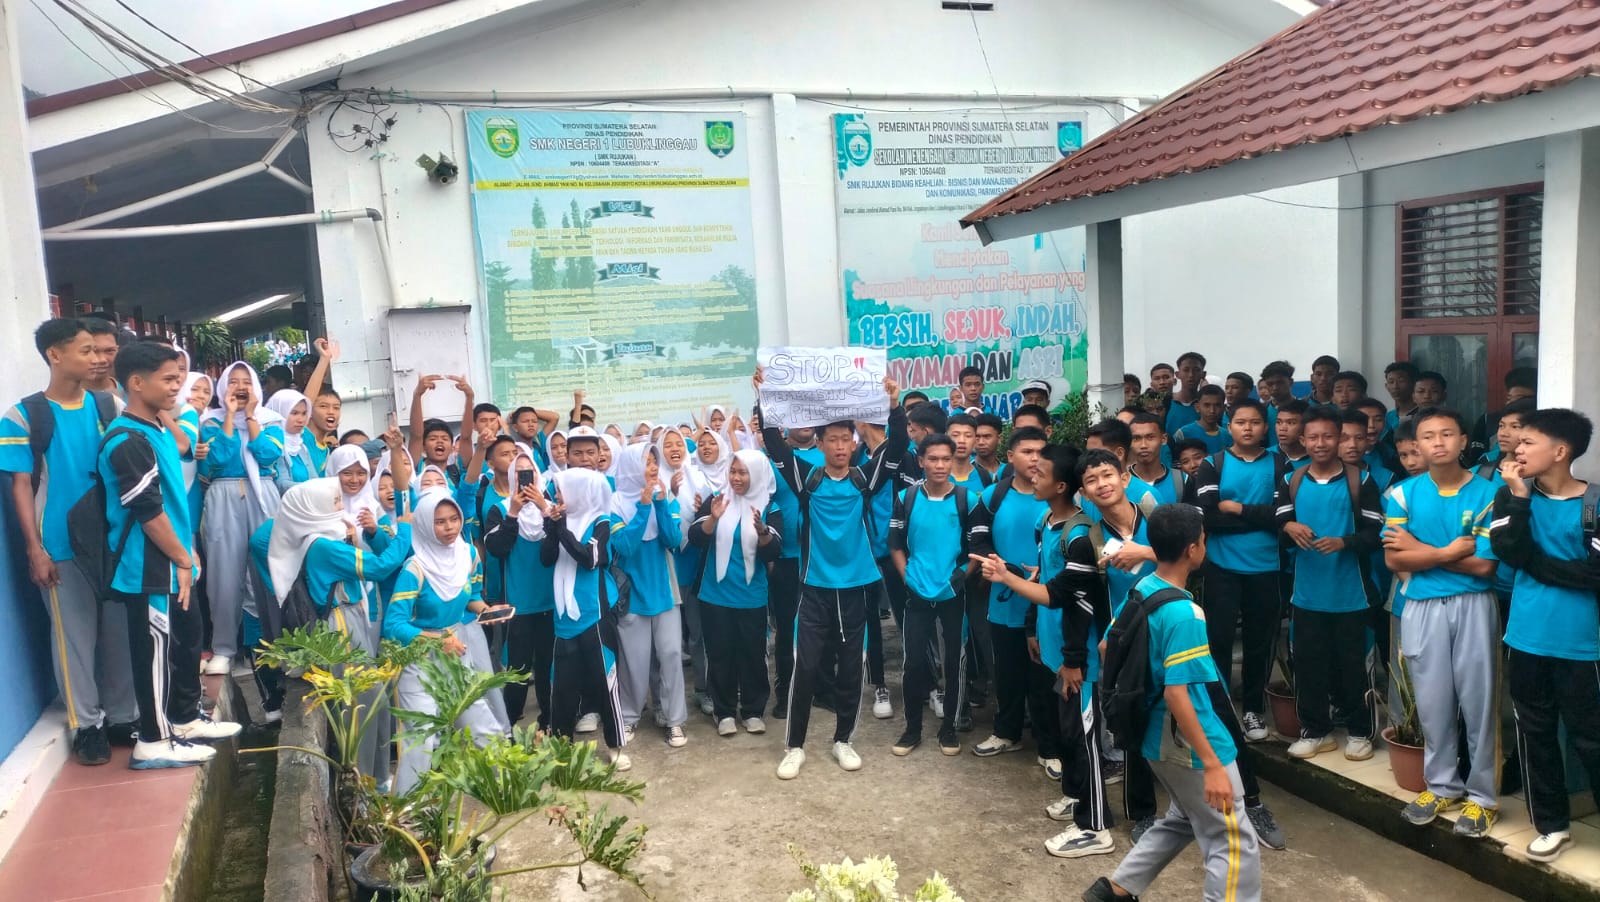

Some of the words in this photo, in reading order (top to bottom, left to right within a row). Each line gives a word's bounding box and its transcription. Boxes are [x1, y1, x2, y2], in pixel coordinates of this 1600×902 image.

[878, 121, 931, 132] PEMERINTAH
[932, 121, 970, 132] PROVINSI
[971, 121, 1014, 132] SUMATERA
[1015, 121, 1049, 131] SELATAN
[530, 137, 556, 151] SMK
[557, 137, 601, 151] NEGERI
[602, 137, 610, 151] 1
[611, 137, 698, 151] LUBUKLINGGAU
[928, 134, 953, 144] DINAS
[954, 133, 1002, 144] PENDIDIKAN
[874, 148, 906, 166] SEKOLAH
[891, 179, 914, 188] BIDANG
[914, 179, 944, 188] KEAHLIAN
[611, 263, 644, 274] Misi
[934, 247, 1009, 273] Menciptakan
[975, 273, 998, 293] dan
[999, 271, 1057, 296] Pelayanan
[1057, 271, 1086, 293] yang
[859, 311, 939, 349] BERSIH,
[943, 306, 1012, 344] SEJUK,
[1015, 301, 1082, 338] INDAH,
[766, 353, 851, 386] STOP
[887, 353, 968, 392] NYAMAN
[971, 350, 1014, 383] DAN
[1016, 344, 1065, 381] ASRI
